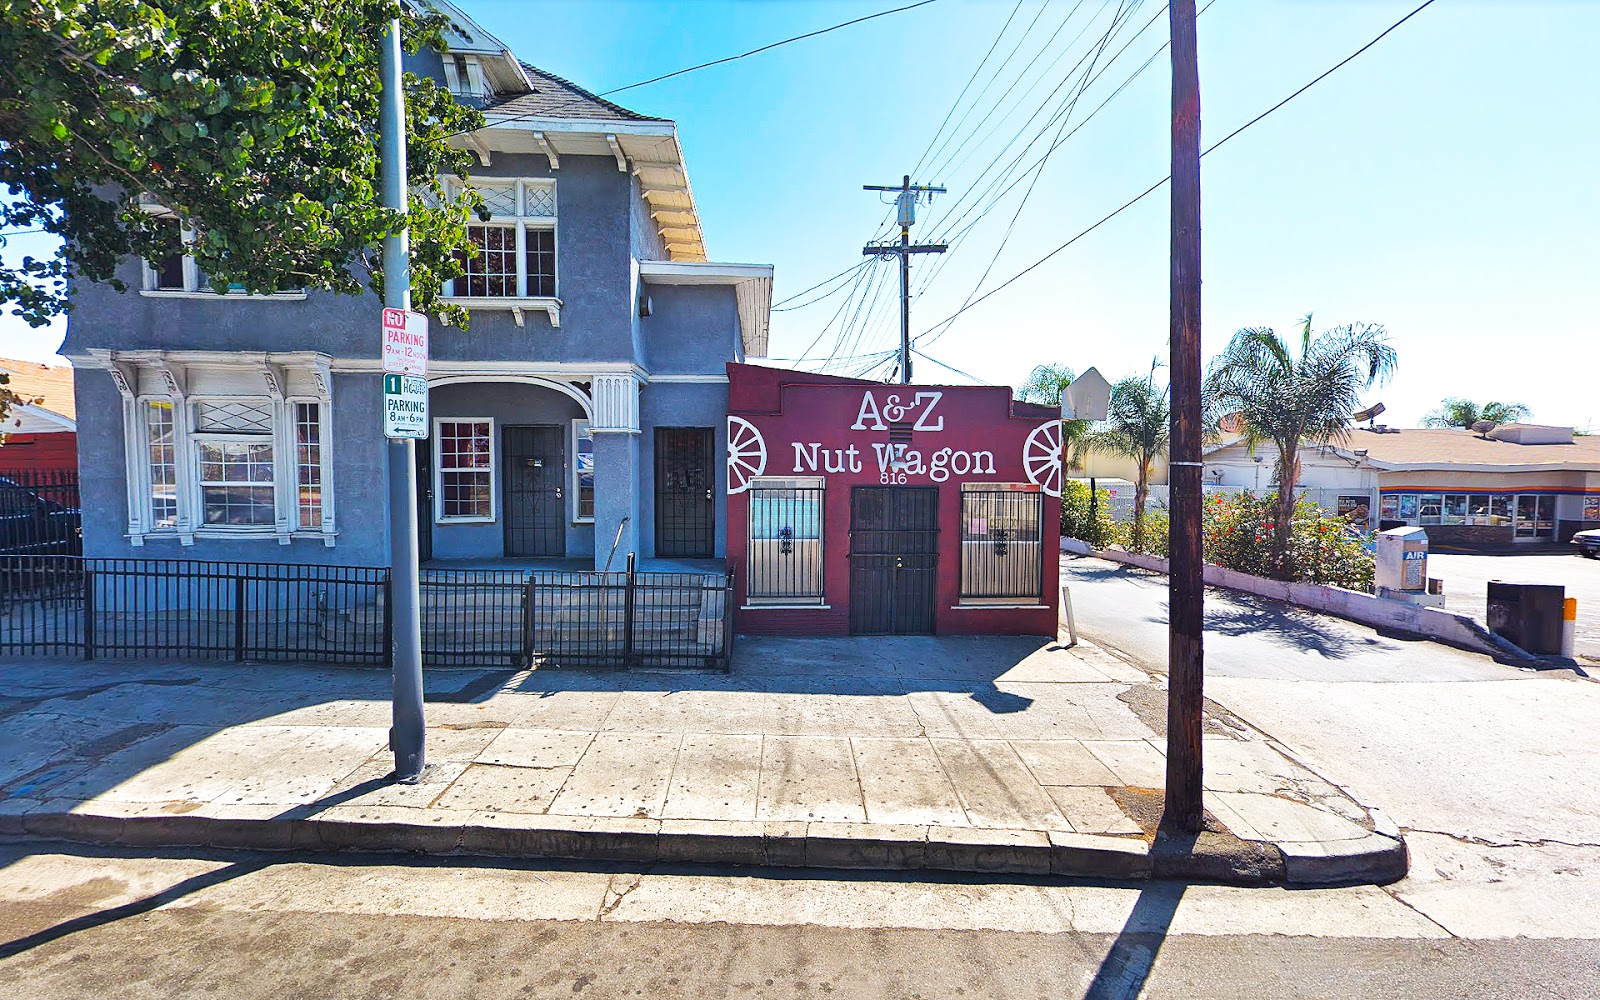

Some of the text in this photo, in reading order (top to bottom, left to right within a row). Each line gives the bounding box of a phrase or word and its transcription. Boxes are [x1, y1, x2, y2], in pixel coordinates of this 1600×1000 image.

[386, 312, 403, 327] NO
[388, 330, 424, 347] PARKING
[390, 377, 396, 392] 1
[388, 398, 425, 413] PARKING
[850, 390, 944, 432] A&Z
[791, 442, 997, 483] Nut Wagon
[880, 472, 908, 485] 816
[1406, 551, 1425, 560] AIR
